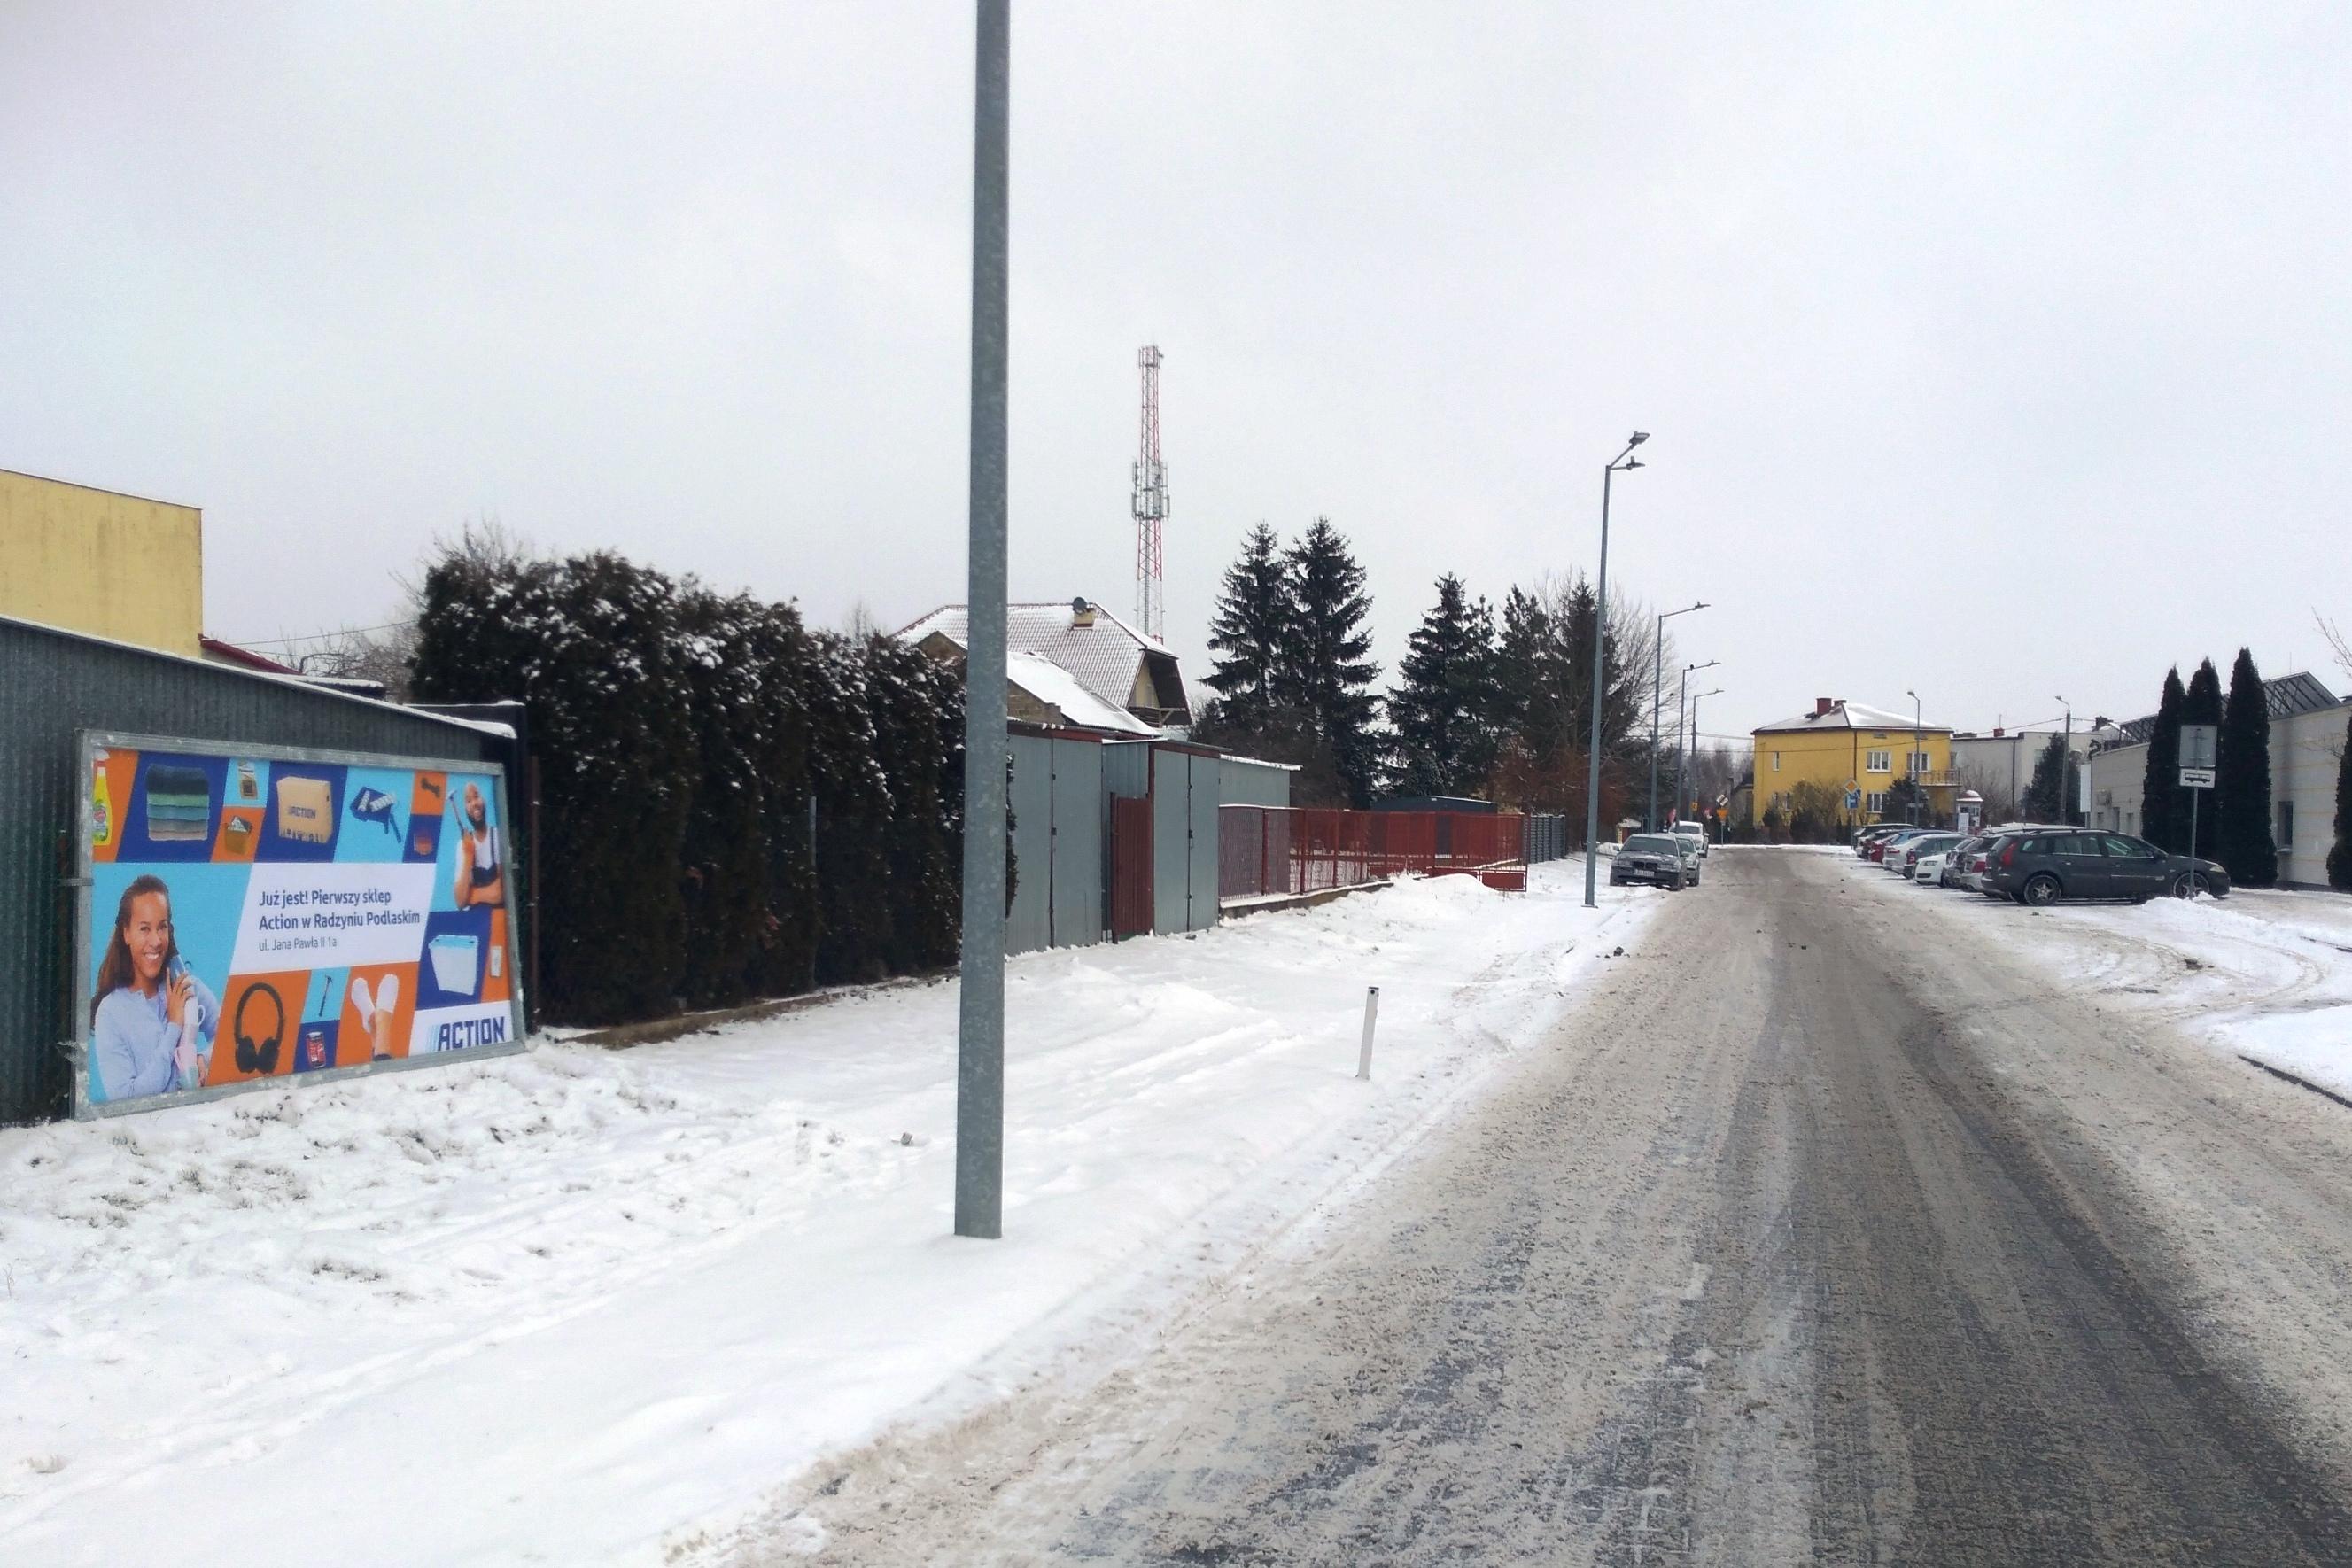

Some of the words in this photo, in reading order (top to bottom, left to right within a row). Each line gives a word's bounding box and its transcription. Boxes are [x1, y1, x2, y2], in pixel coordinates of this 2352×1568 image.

[259, 890, 279, 906] Już
[281, 889, 308, 909] jest!
[312, 889, 360, 907] Pierwszy
[363, 888, 391, 905] sklep
[259, 913, 299, 930] Action
[301, 918, 311, 928] w
[314, 912, 363, 930] Radzyniu
[367, 909, 420, 927] Podlaskim
[259, 939, 269, 951] ul.
[272, 939, 292, 951] Jana
[294, 936, 318, 949] Pawła
[328, 936, 338, 947] 1a
[438, 1016, 505, 1052] ACTION
